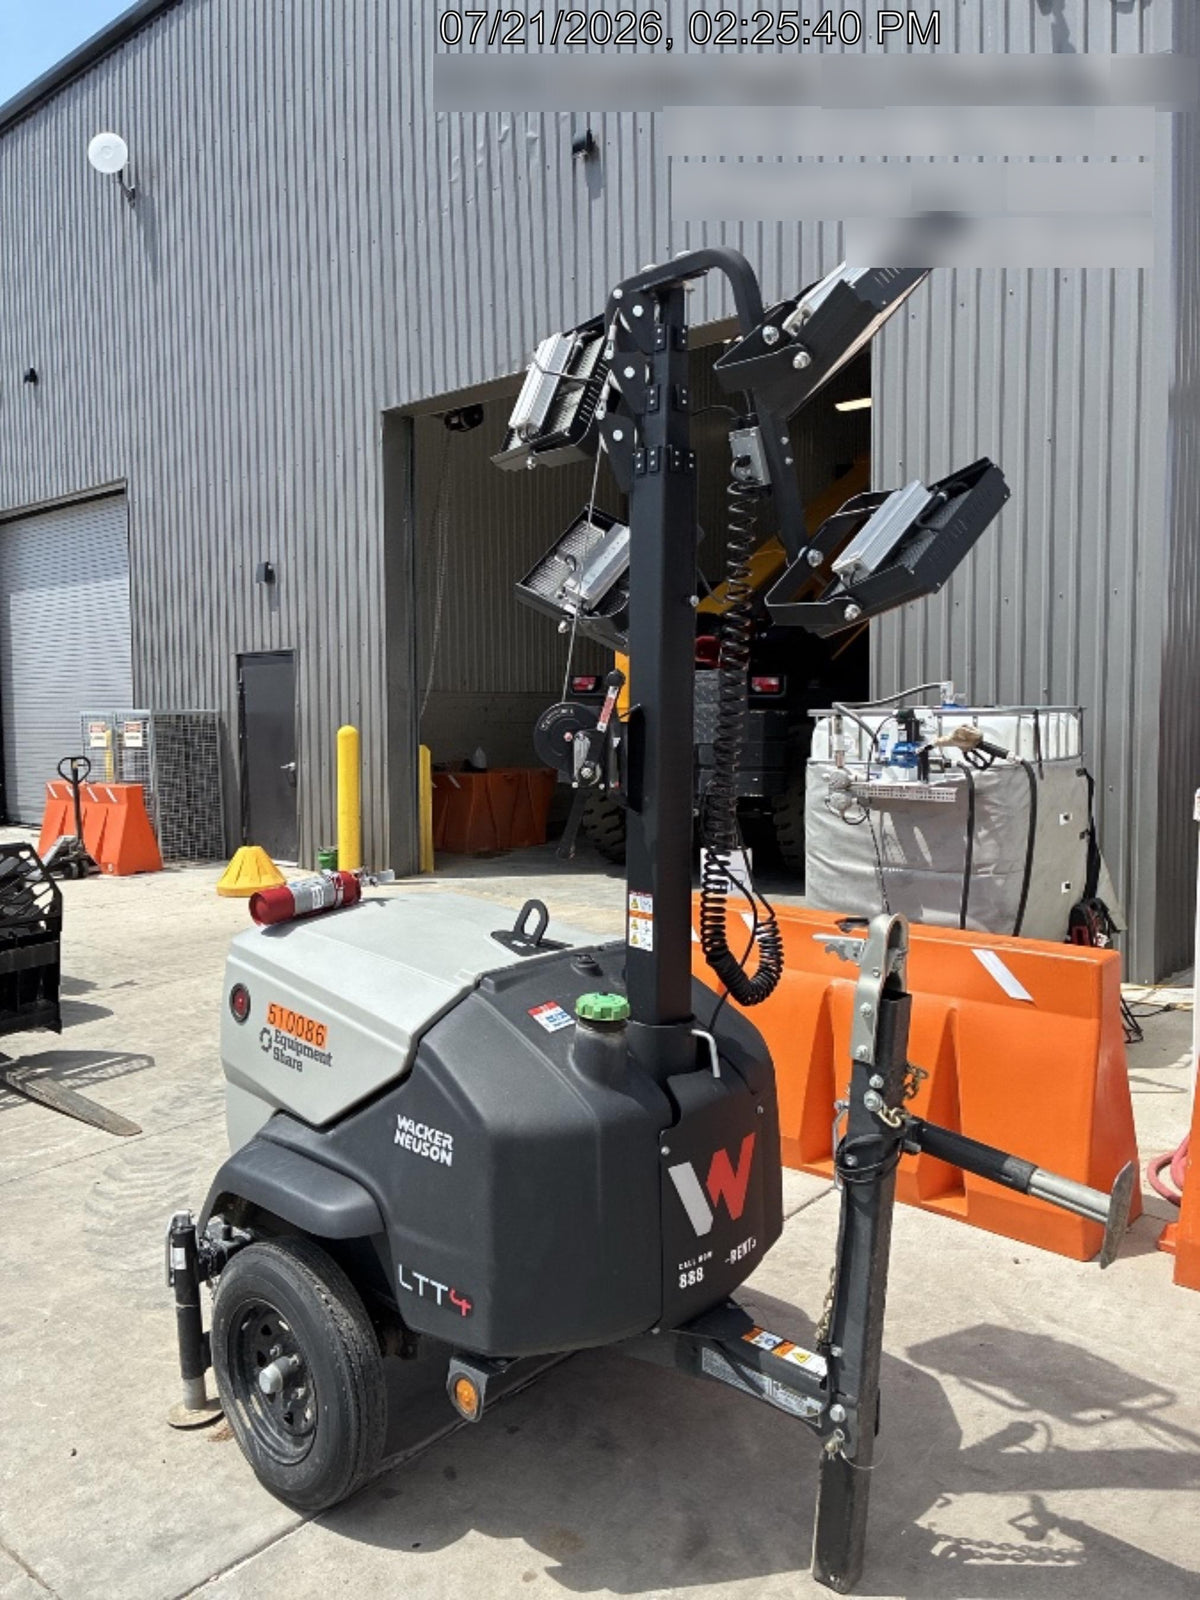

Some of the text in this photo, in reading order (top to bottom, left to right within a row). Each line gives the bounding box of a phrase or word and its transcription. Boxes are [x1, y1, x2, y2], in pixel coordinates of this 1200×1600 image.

[267, 1003, 325, 1047] 510086
[272, 1046, 303, 1073] Share
[273, 1028, 333, 1068] Equipment
[393, 1128, 453, 1167] NEUSON
[397, 1113, 454, 1151] WACKER
[398, 1264, 472, 1317] LTT4
[678, 1266, 704, 1289] 888
